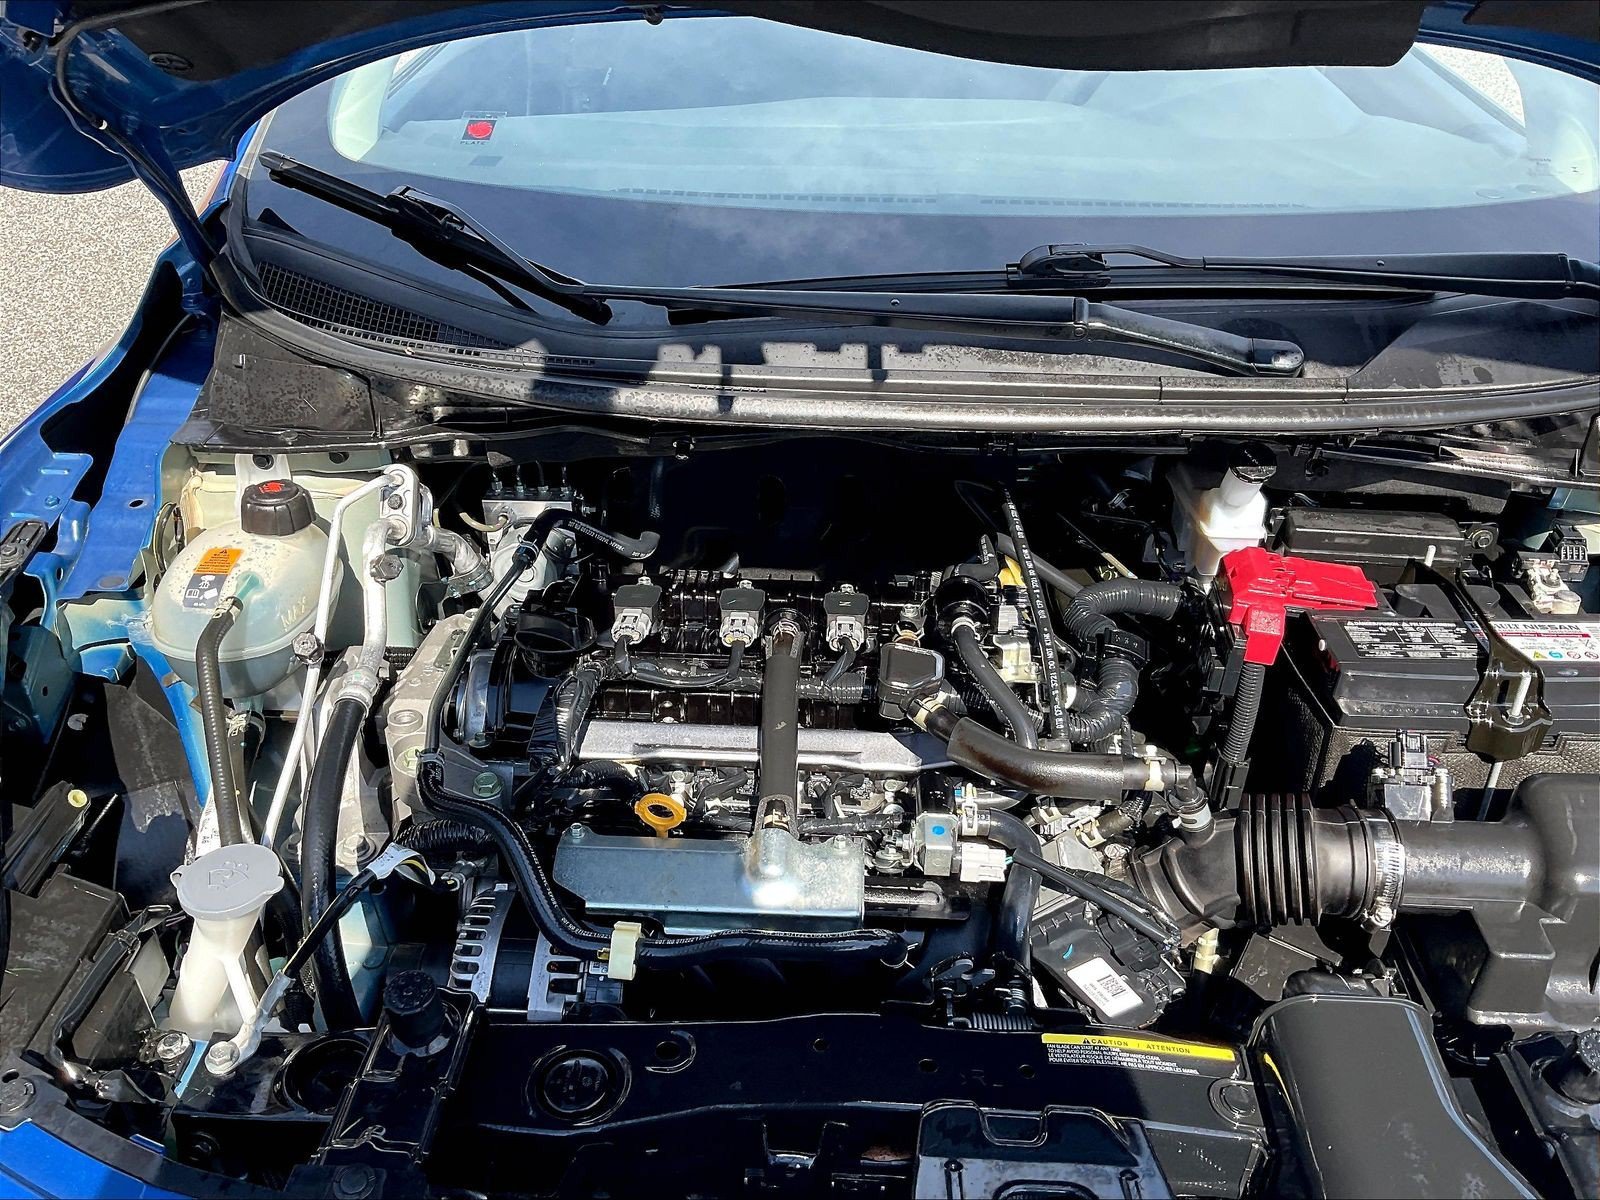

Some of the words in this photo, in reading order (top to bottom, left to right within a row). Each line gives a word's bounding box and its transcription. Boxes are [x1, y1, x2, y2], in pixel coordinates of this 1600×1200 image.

[1046, 648, 1054, 659] NOT
[1091, 1039, 1128, 1047] CAUTION
[1146, 1044, 1190, 1053] ATTENTION
